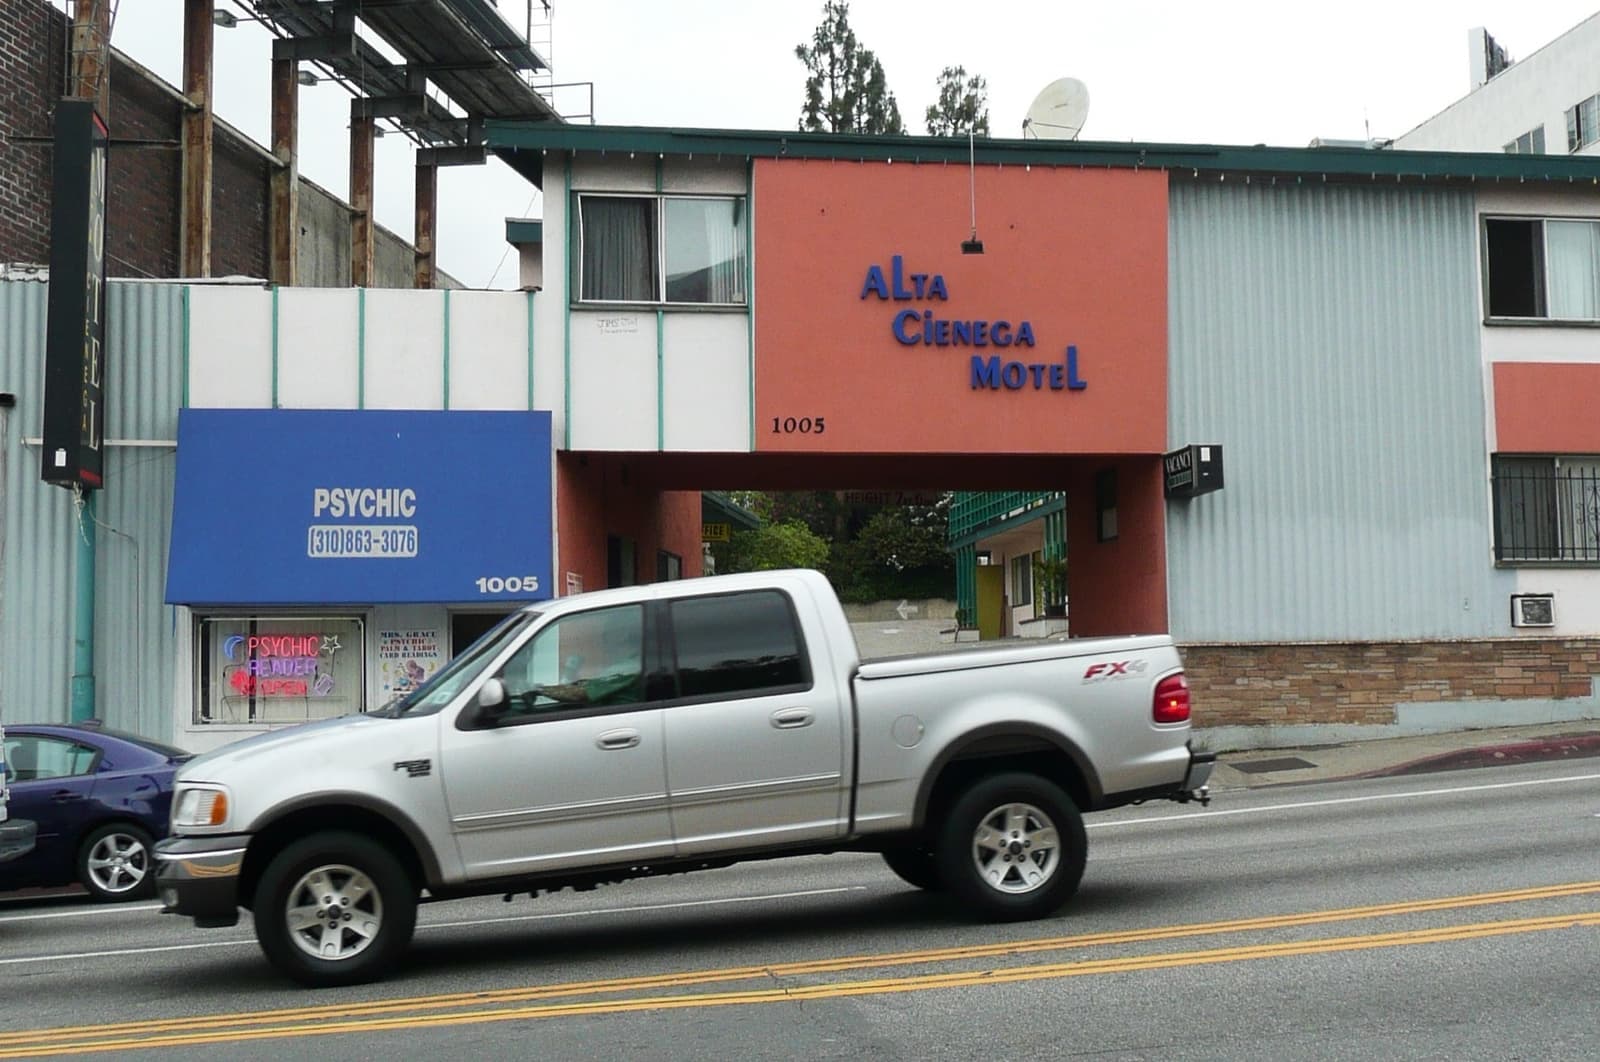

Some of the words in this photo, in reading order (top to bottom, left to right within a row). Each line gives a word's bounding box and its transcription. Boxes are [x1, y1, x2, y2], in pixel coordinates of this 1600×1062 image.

[861, 254, 948, 301] ALTA
[88, 146, 106, 452] MOTEL
[970, 345, 1087, 391] MOTEL
[772, 416, 825, 434] 1005
[313, 487, 417, 518] PSYCHIC
[309, 529, 417, 555] (310)863-3076
[702, 523, 726, 537] FICE
[475, 576, 539, 593] 1005
[248, 636, 319, 657] PSYCHIC
